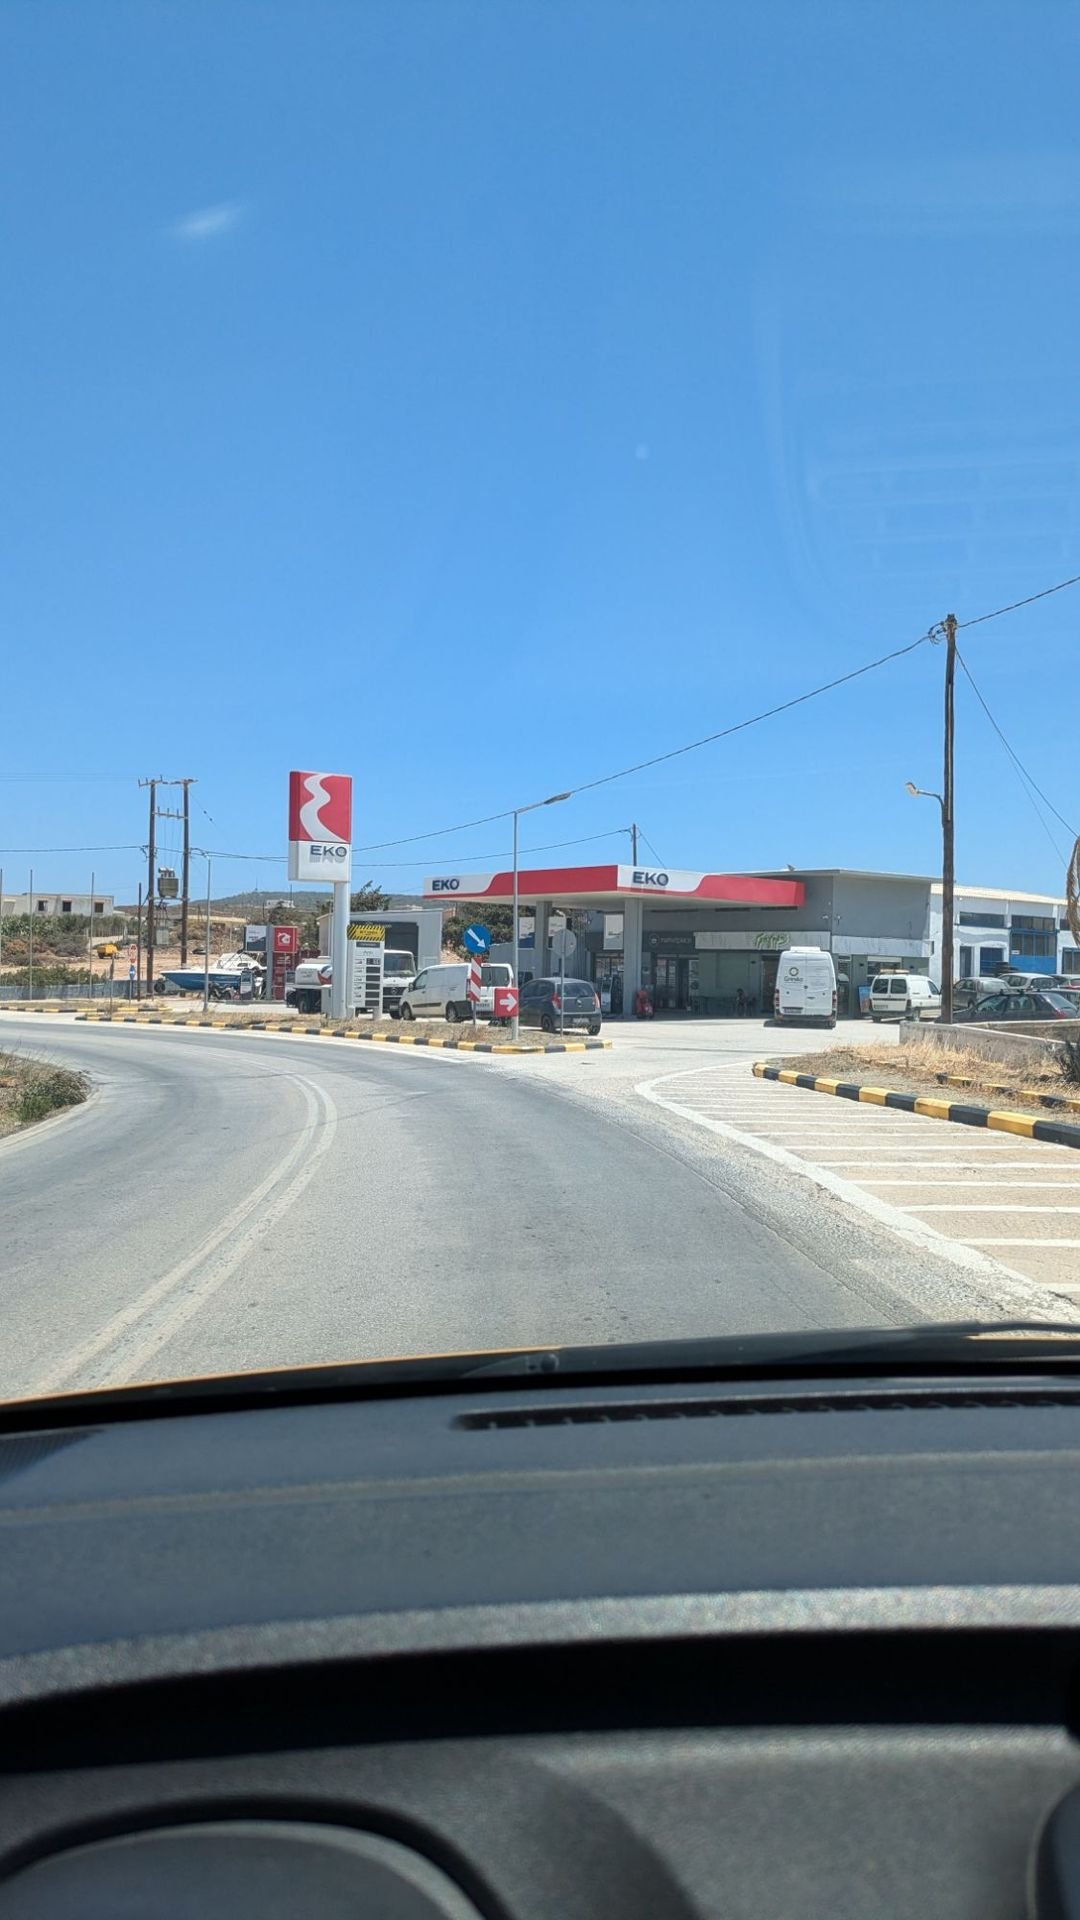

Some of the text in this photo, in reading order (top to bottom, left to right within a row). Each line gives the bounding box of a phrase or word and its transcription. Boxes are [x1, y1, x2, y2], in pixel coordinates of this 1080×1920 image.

[310, 845, 347, 858] EKO
[432, 878, 459, 891] EKO
[633, 871, 669, 886] EKO
